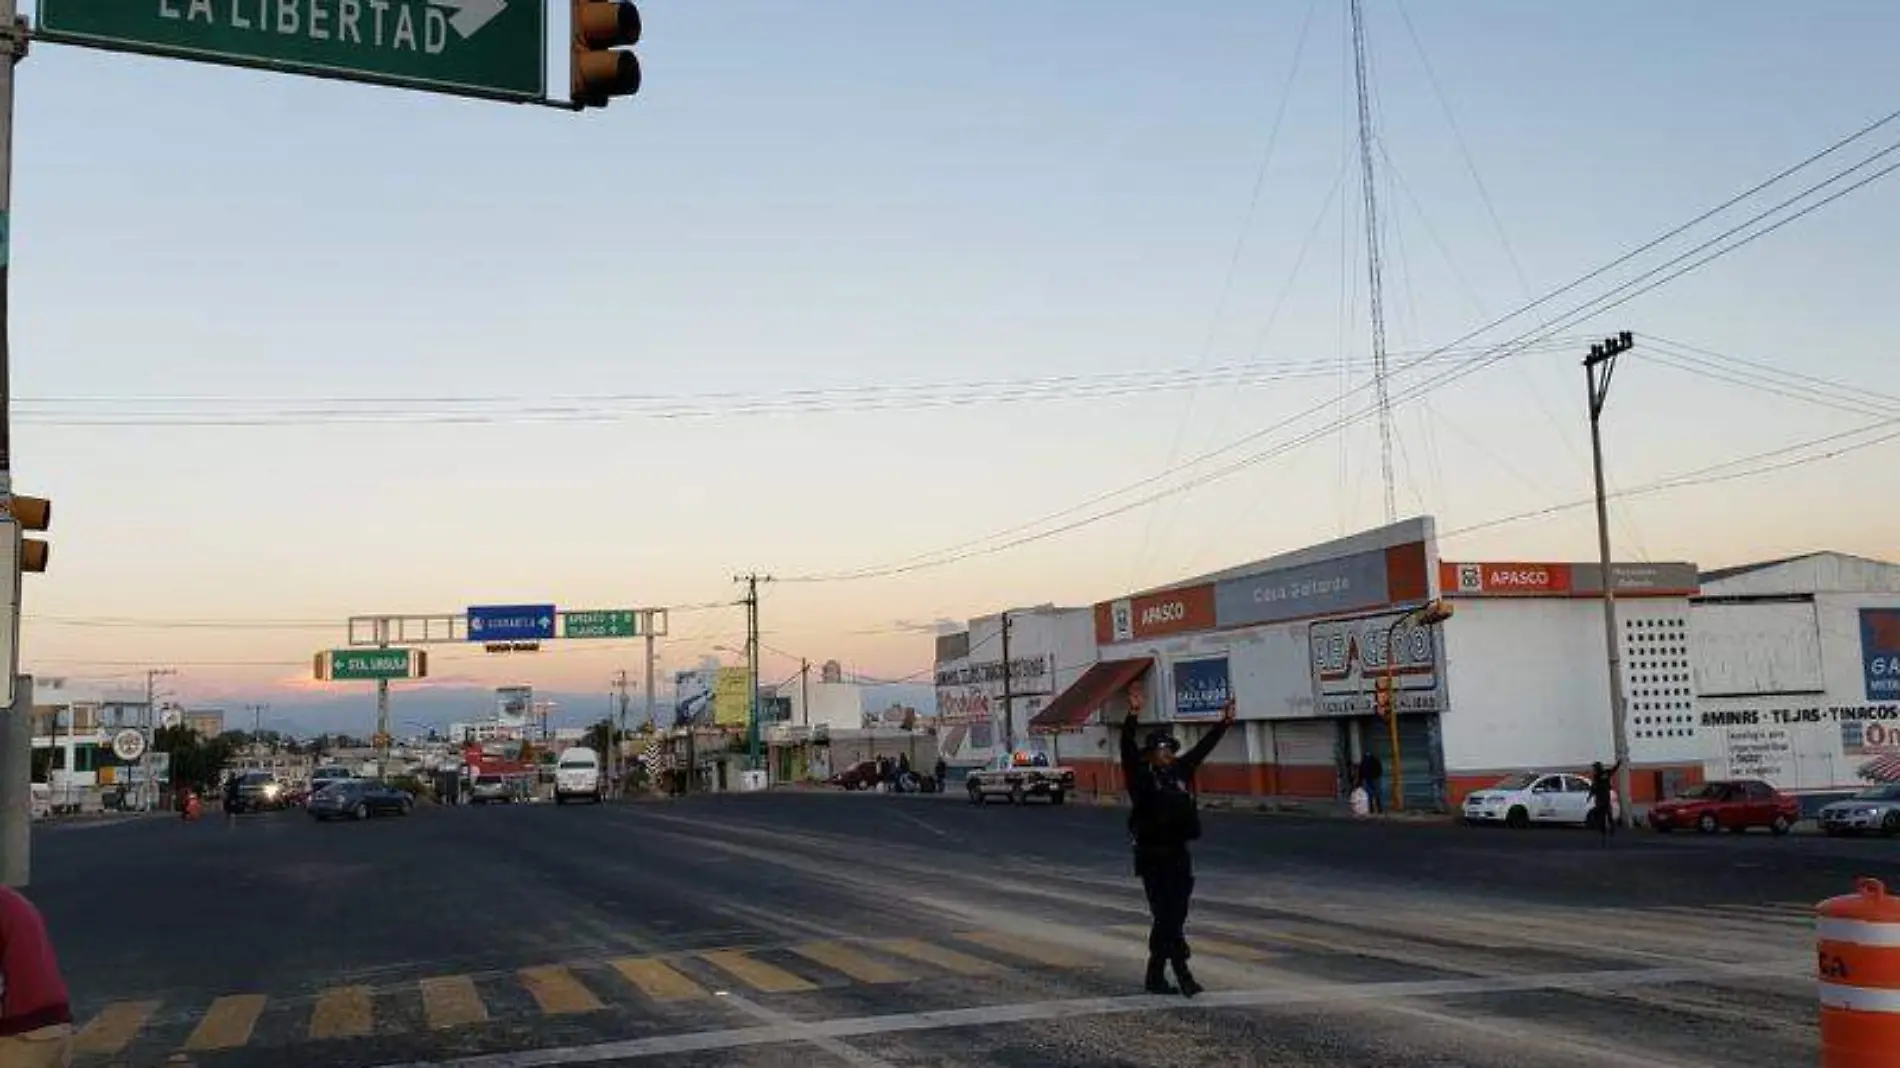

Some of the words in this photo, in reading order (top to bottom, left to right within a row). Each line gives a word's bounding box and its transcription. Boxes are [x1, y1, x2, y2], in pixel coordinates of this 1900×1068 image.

[231, 0, 446, 54] LIBERTAD
[1490, 570, 1549, 585] APASCO
[1142, 602, 1184, 625] APASCO
[1771, 707, 1821, 724] TEJAS
[1829, 703, 1899, 722] TINACOS
